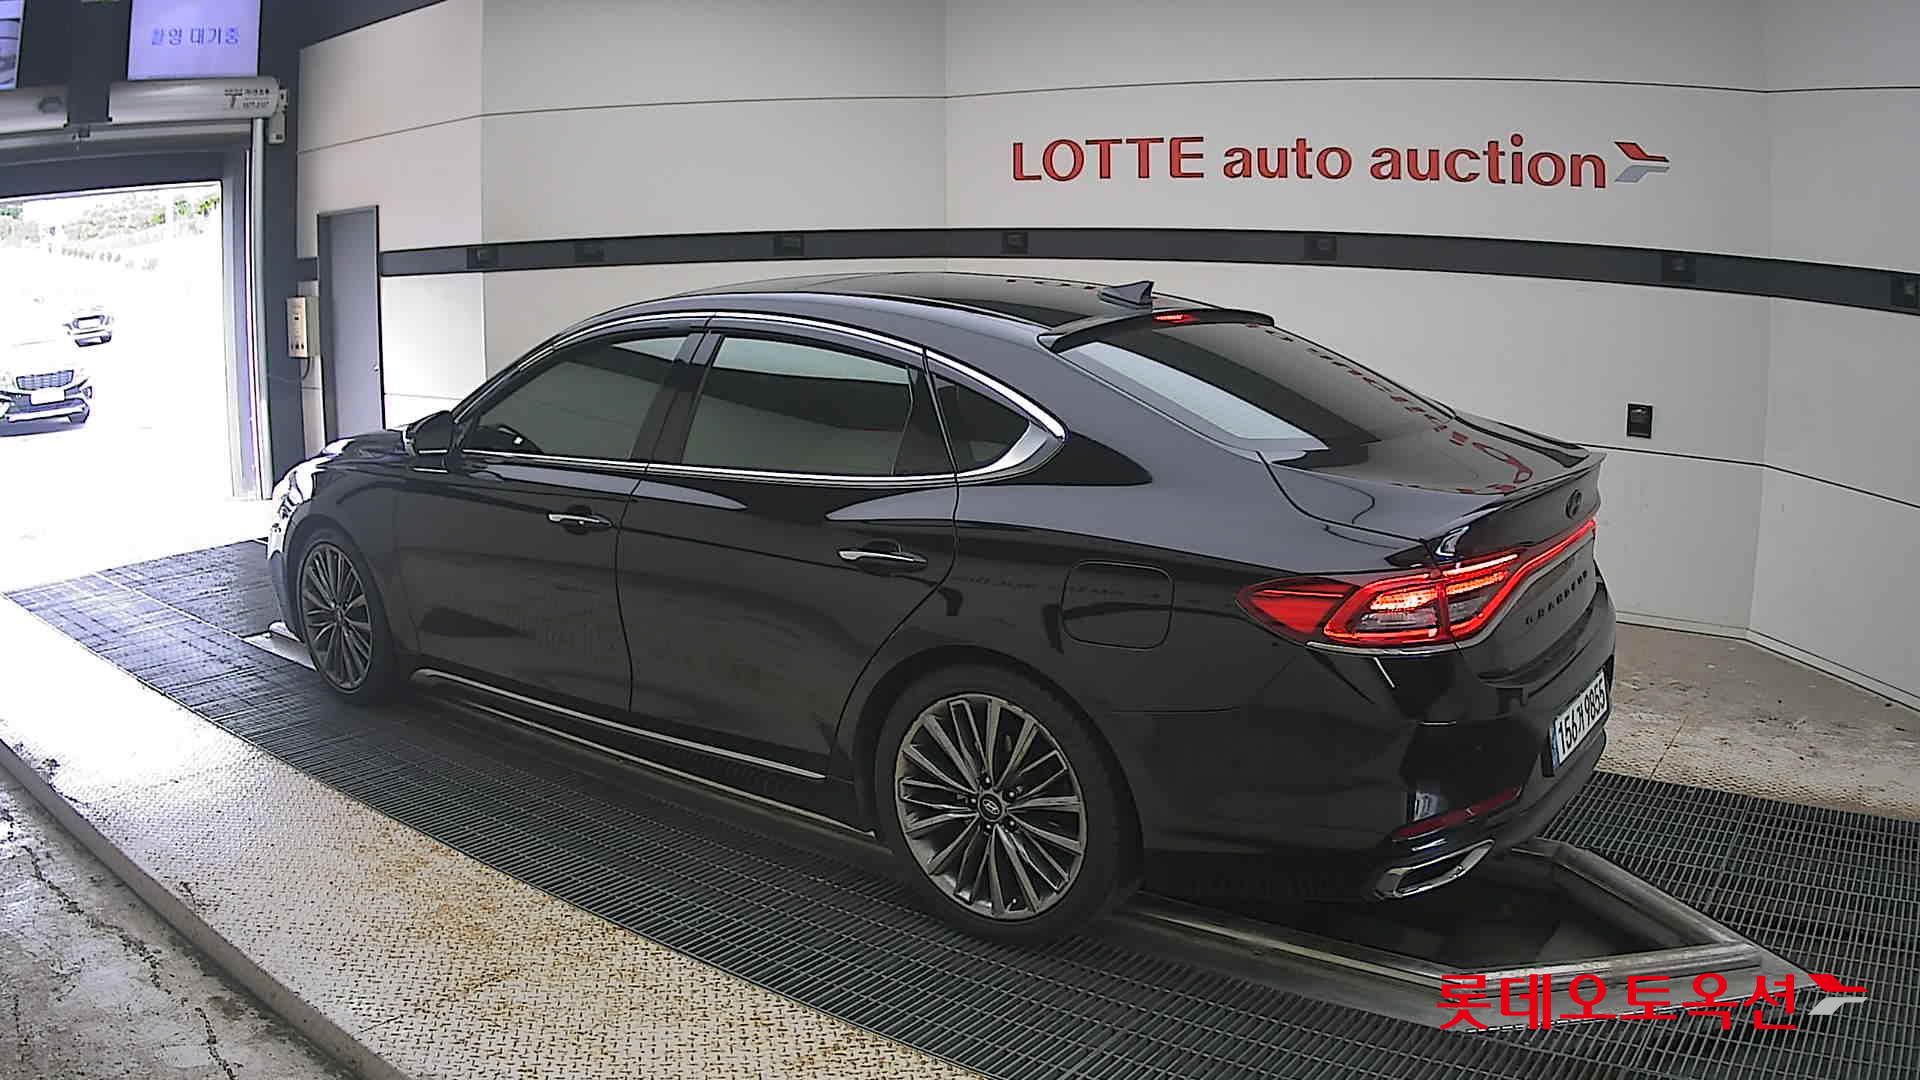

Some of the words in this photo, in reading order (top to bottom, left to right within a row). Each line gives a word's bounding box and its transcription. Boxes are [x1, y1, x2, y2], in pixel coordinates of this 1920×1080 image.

[190, 26, 239, 45] 대기중
[1012, 136, 1205, 181] LOTTE
[1224, 138, 1353, 180] auto
[1369, 134, 1607, 188] auction
